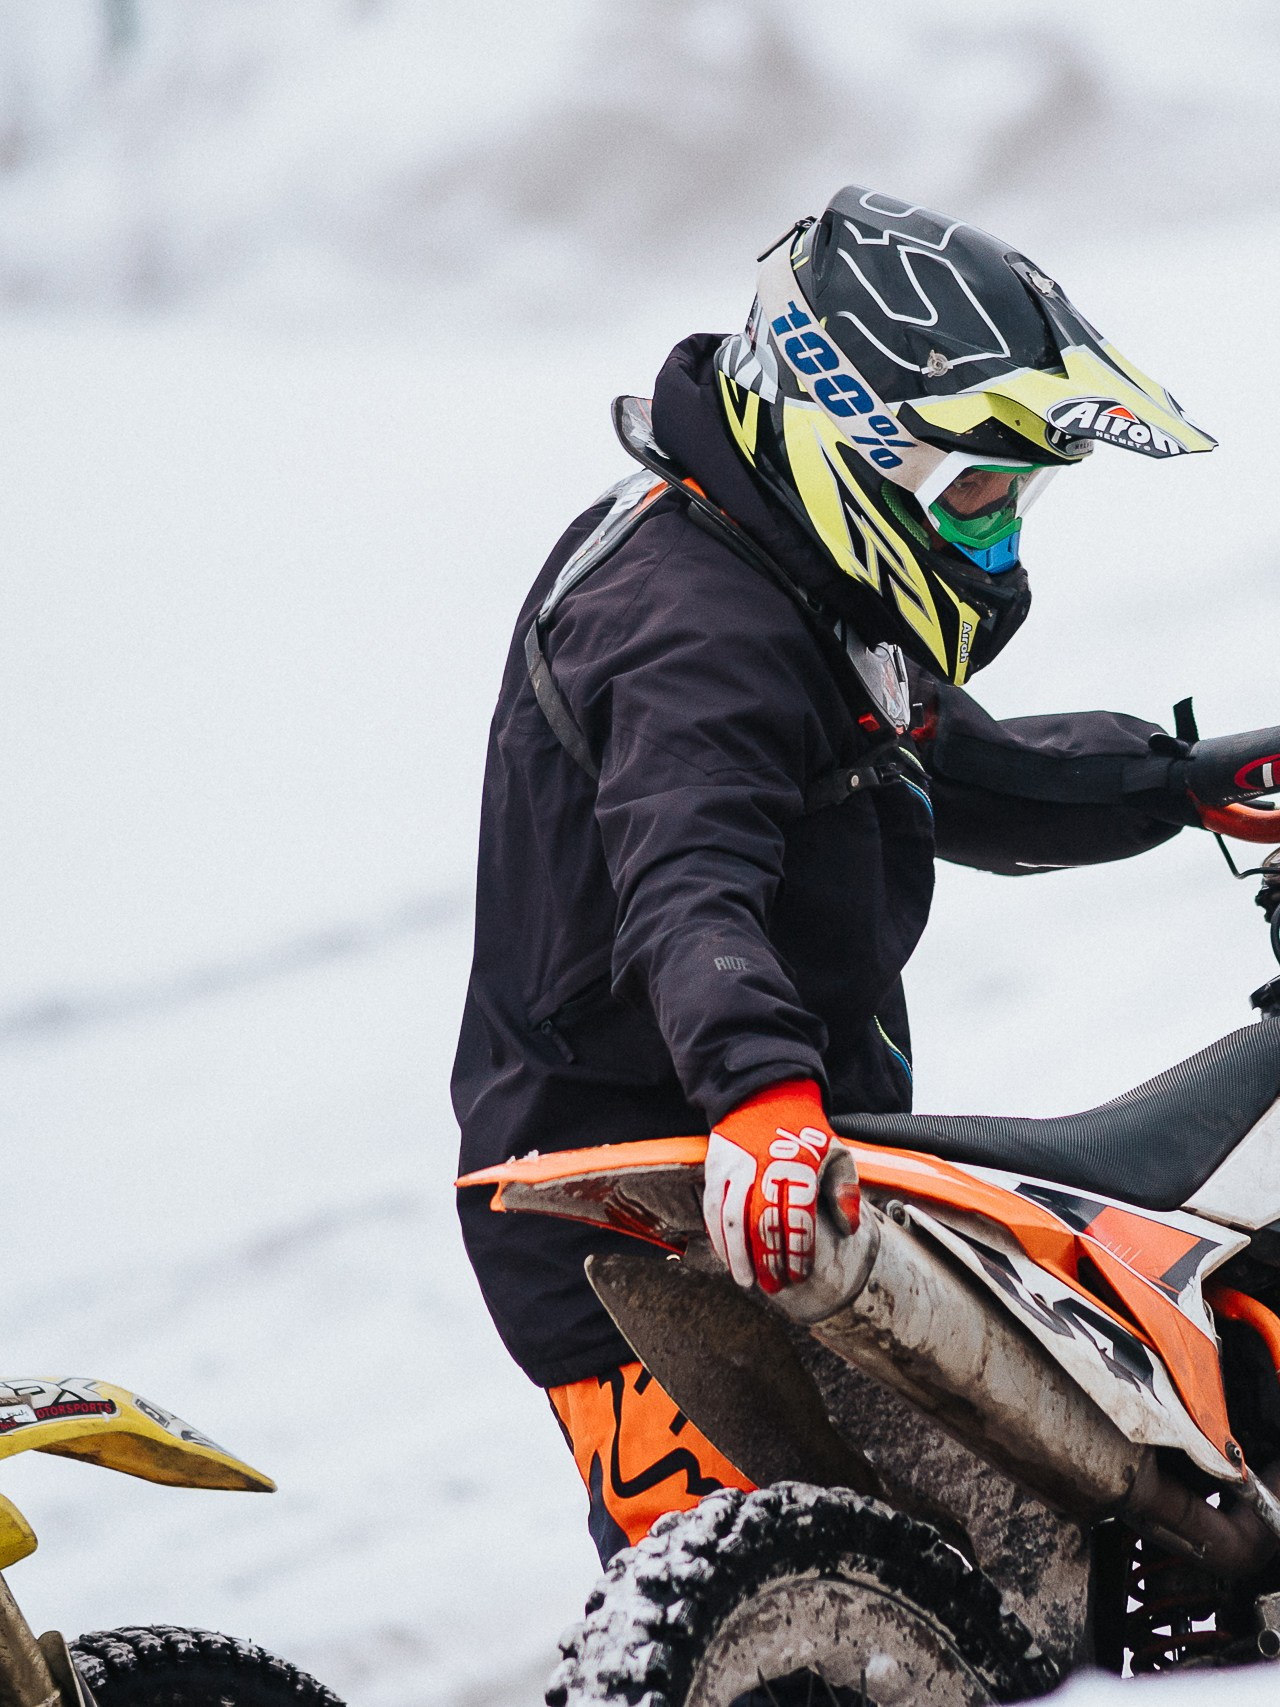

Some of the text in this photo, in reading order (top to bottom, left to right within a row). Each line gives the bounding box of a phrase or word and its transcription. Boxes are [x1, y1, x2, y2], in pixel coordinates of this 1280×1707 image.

[771, 300, 918, 469] 100%
[960, 621, 972, 663] Airoh
[36, 1402, 113, 1419] OTORSPORTS
